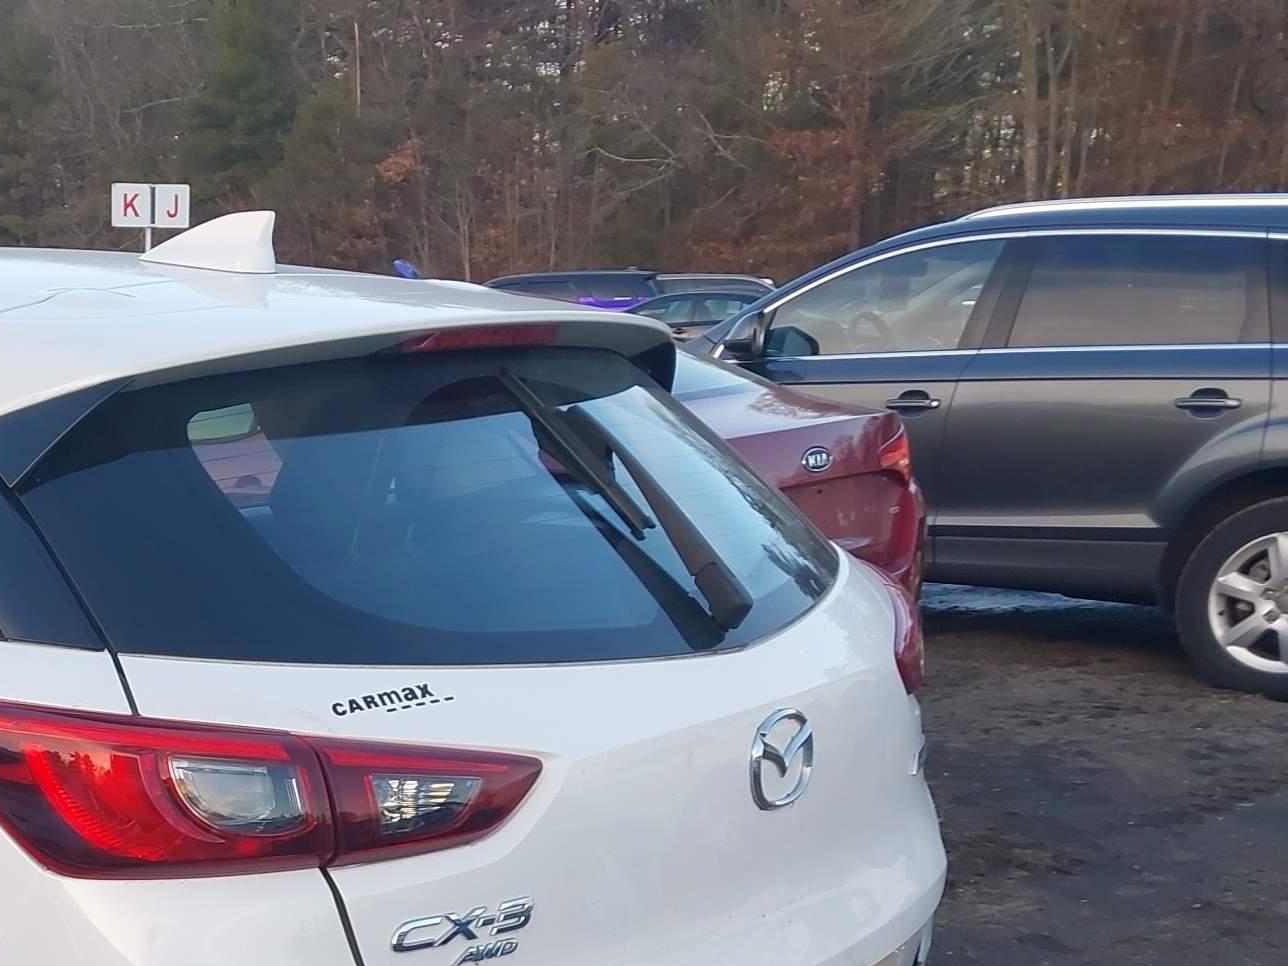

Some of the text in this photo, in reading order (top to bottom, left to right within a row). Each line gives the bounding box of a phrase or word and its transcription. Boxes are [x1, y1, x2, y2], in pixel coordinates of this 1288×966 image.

[123, 193, 140, 217] K
[166, 194, 179, 218] J
[391, 896, 535, 952] CX-3
[452, 937, 519, 966] AWD
